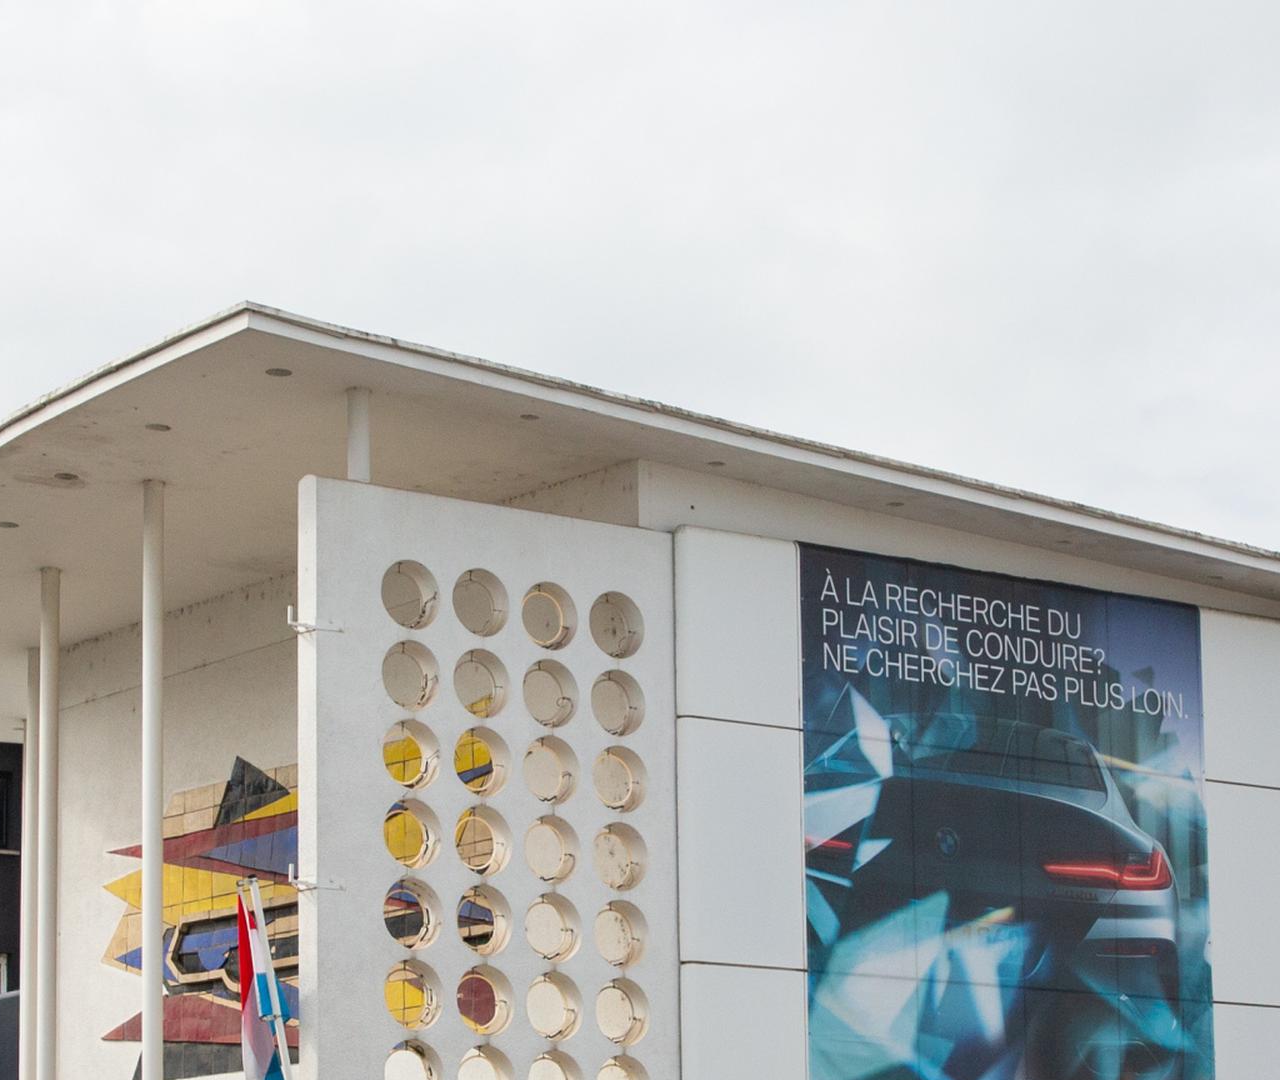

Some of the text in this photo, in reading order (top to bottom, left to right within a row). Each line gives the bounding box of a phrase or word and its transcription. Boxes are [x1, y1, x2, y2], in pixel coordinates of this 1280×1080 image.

[820, 568, 1081, 640] À LA RECHERCHE DU
[822, 608, 1105, 675] PLAISIR DE CONDUIRE?
[823, 642, 1189, 719] NE CHERCHEZ PAS PLUS LOIN.
